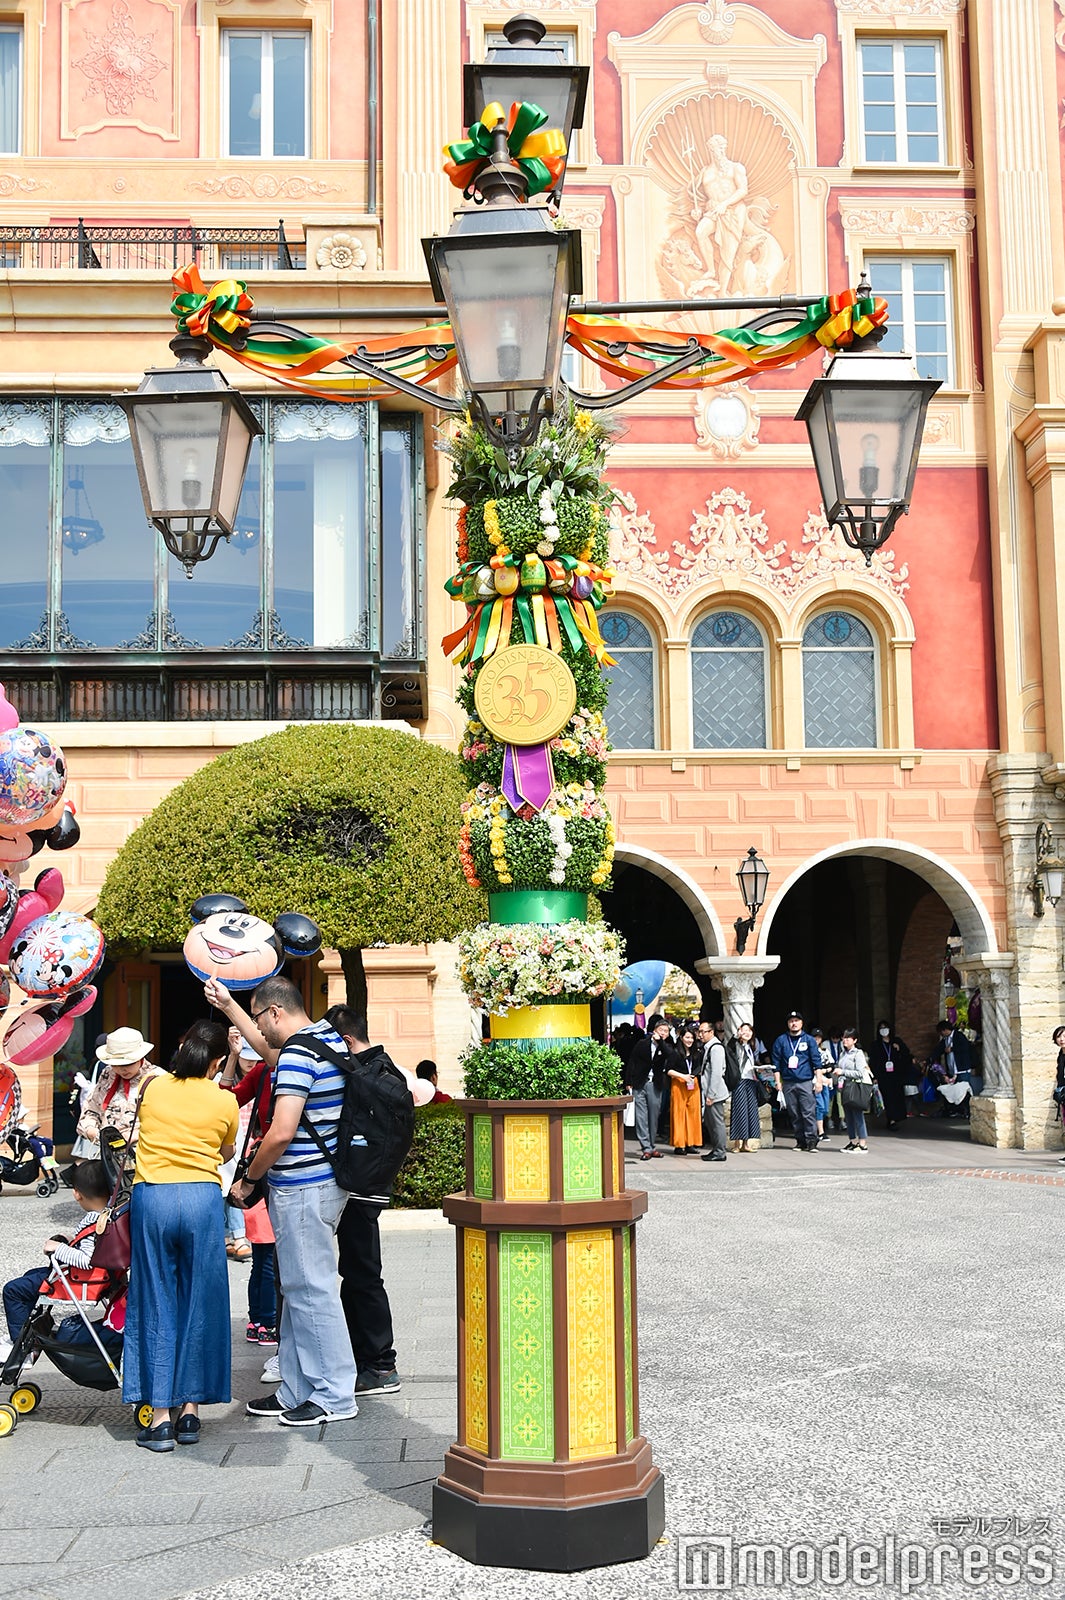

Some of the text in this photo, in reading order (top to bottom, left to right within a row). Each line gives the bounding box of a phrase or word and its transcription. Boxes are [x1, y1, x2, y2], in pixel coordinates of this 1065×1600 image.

[481, 669, 497, 715] TOKYO
[496, 651, 545, 670] DISNEY
[490, 661, 555, 727] 35
